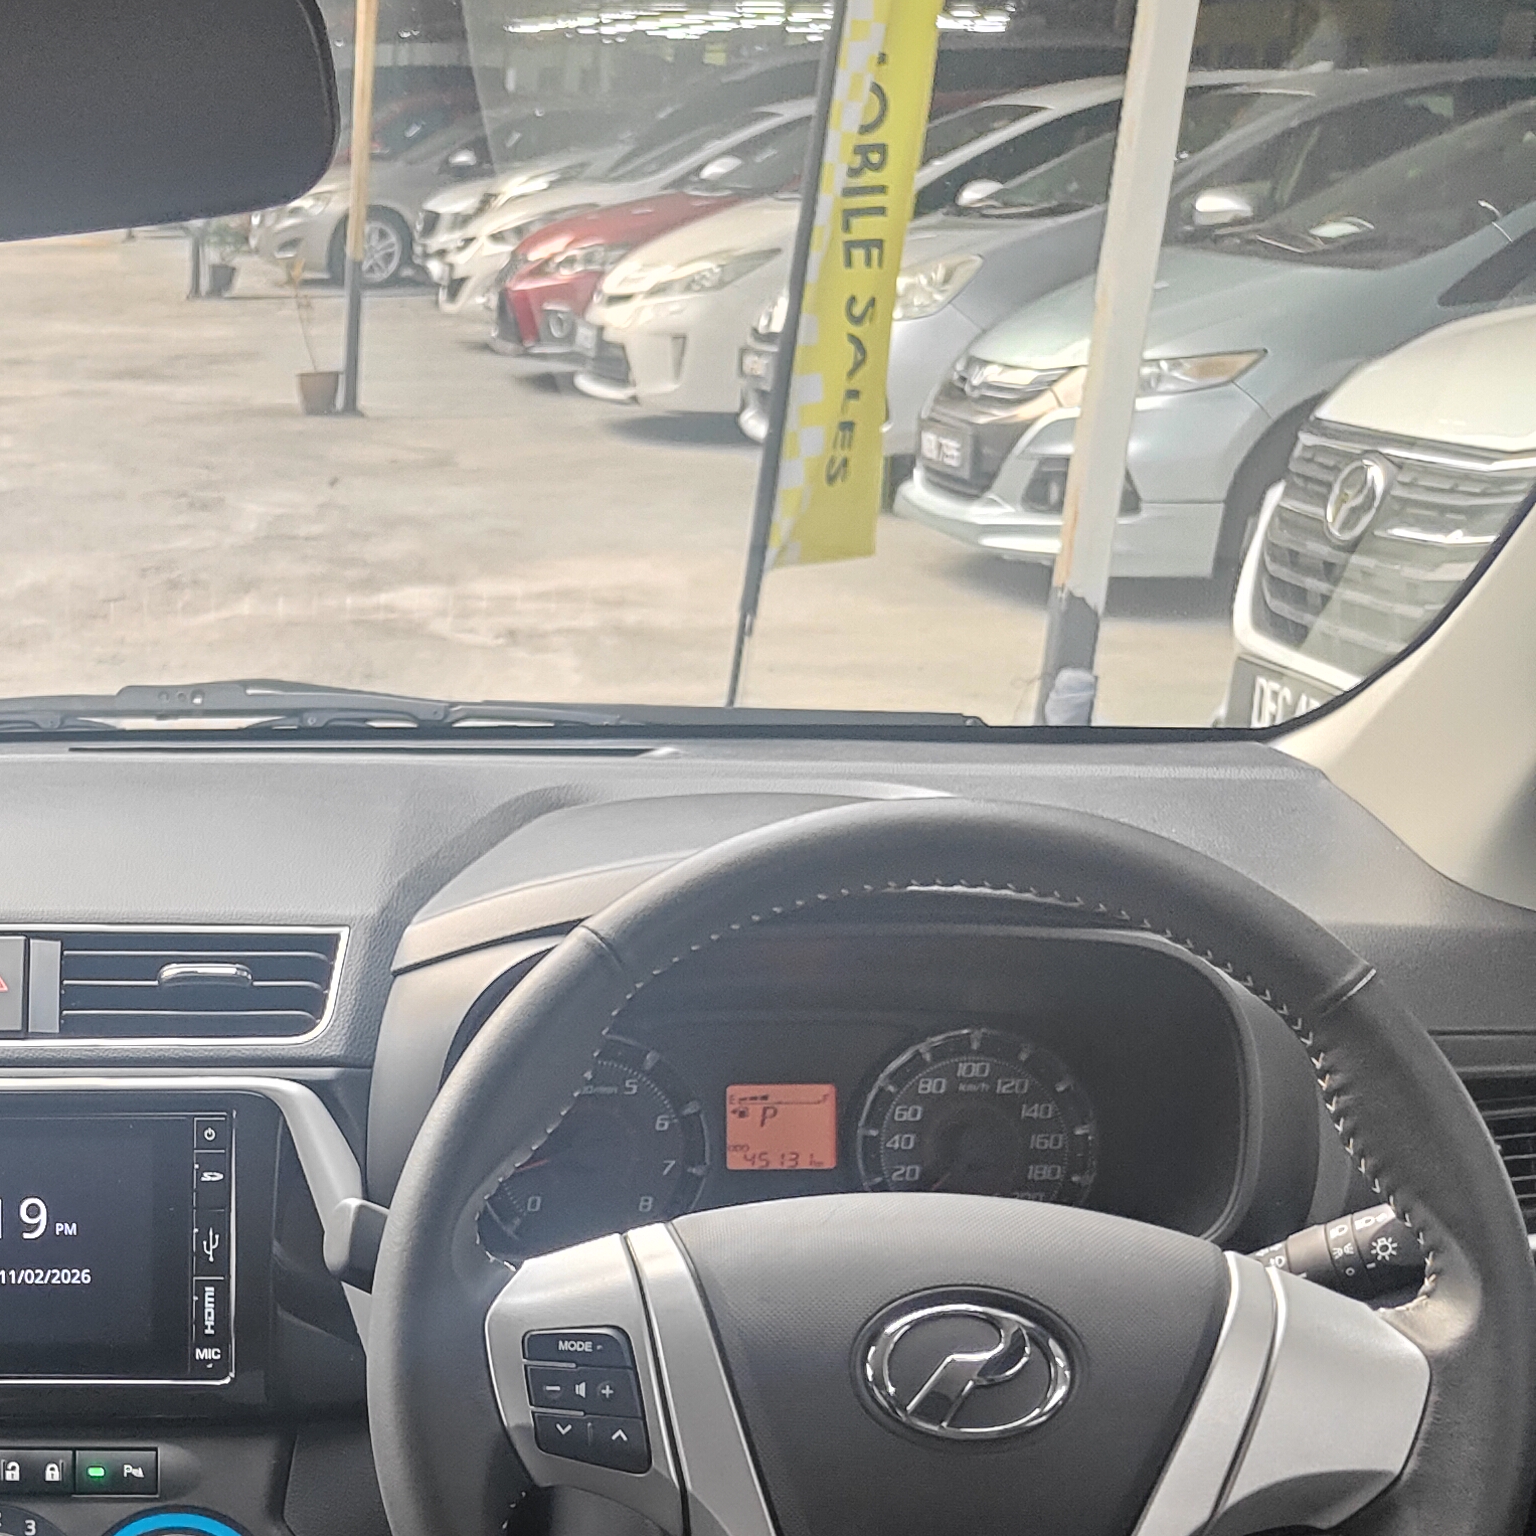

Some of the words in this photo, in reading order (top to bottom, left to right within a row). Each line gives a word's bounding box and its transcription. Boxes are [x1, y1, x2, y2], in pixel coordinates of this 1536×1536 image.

[840, 50, 889, 269] OBILE
[825, 294, 876, 486] SALES
[956, 1061, 990, 1078] 100
[623, 1078, 638, 1095] 5
[917, 1077, 947, 1094] 80
[995, 1078, 1029, 1094] 120
[760, 1105, 778, 1128] P
[893, 1105, 923, 1122] 60
[1021, 1103, 1053, 1119] 140
[655, 1114, 670, 1131] 6
[885, 1133, 916, 1150] 40
[1030, 1133, 1063, 1150] 160
[662, 1159, 676, 1176] 7
[891, 1164, 921, 1181] 20
[1027, 1164, 1061, 1181] 180
[526, 1196, 542, 1212] 0
[638, 1196, 654, 1213] 8
[55, 1222, 77, 1236] PM
[204, 1286, 215, 1335] HDMI
[195, 1347, 221, 1360] MIC
[558, 1339, 593, 1352] MODE
[24, 1519, 37, 1536] 3
